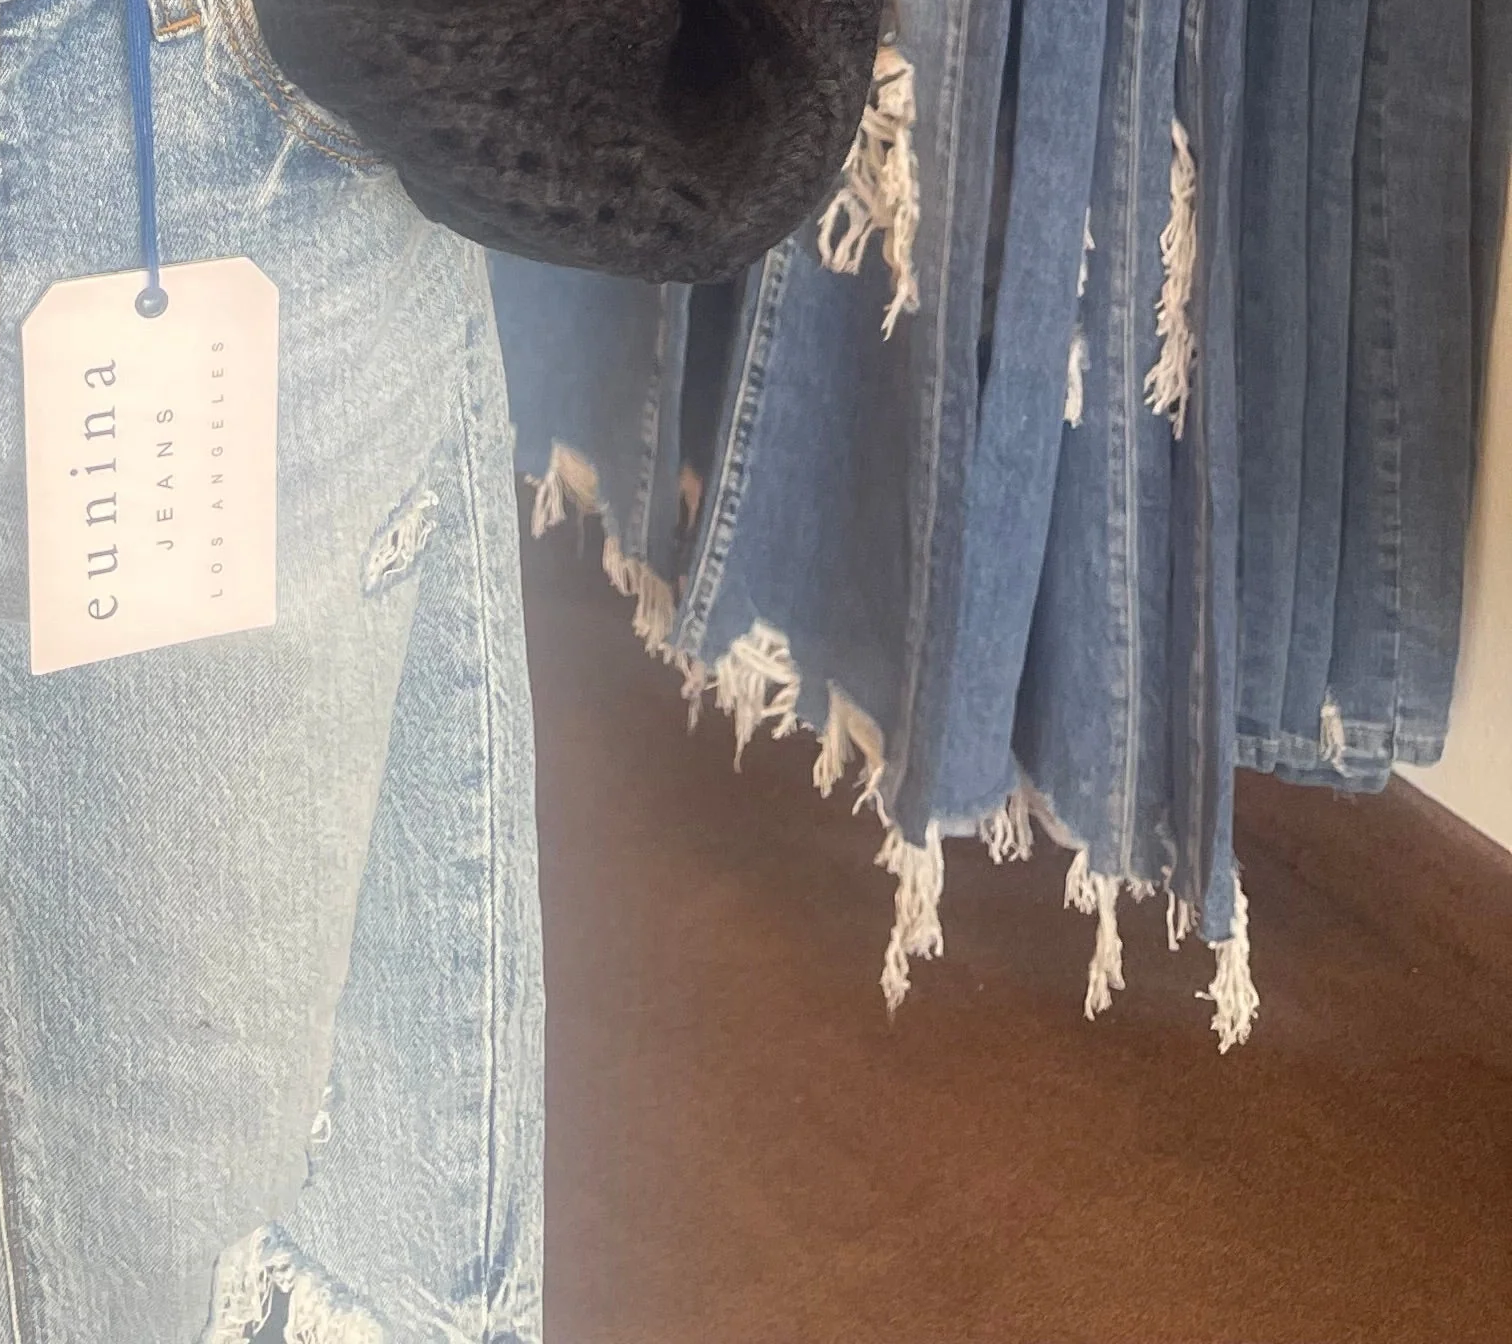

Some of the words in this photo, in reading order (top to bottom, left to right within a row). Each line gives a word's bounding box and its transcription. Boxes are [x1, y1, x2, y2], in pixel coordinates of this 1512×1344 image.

[70, 359, 119, 621] eunina
[156, 409, 175, 551] JEANS
[211, 342, 225, 511] ANGELES
[211, 536, 225, 599] LOS
